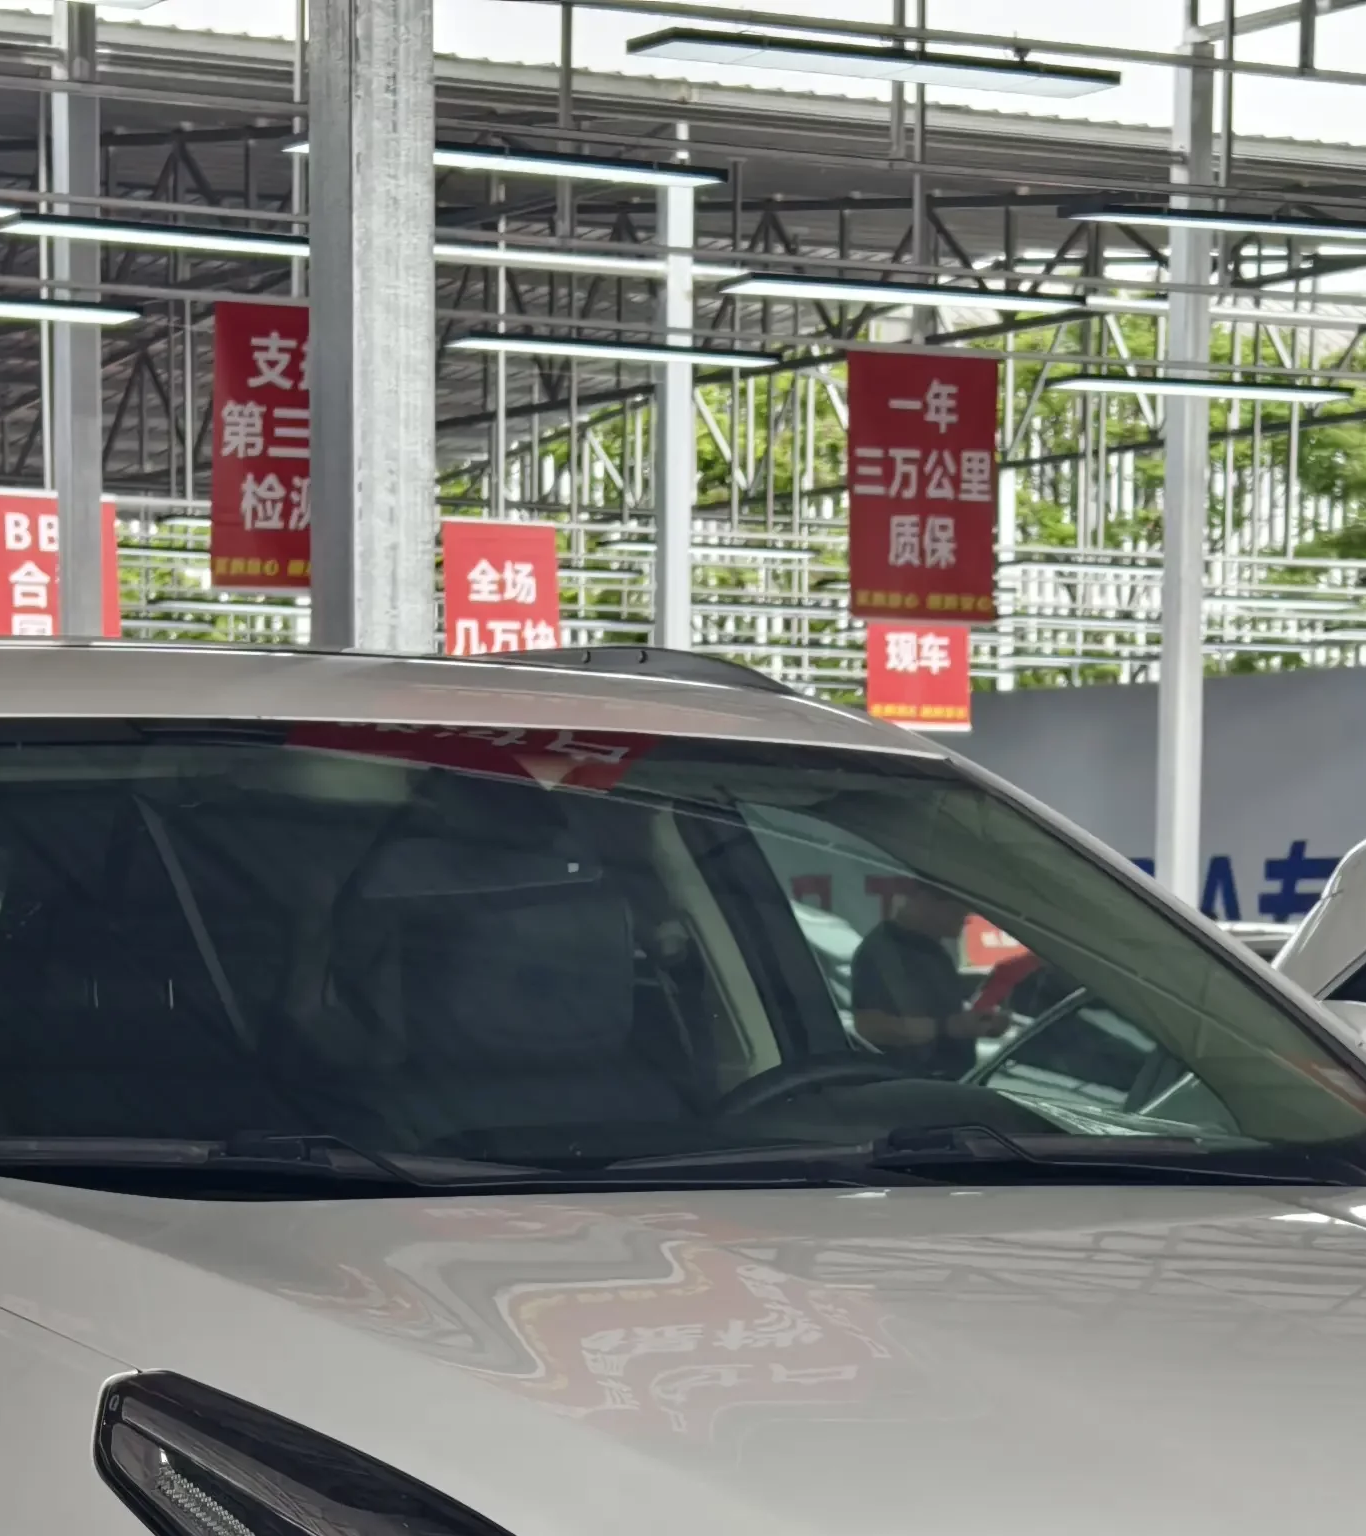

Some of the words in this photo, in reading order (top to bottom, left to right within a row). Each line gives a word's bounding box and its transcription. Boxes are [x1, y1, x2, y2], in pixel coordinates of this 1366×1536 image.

[888, 379, 958, 433] 一年
[854, 448, 992, 502] 三万公里
[888, 515, 956, 568] 质保
[467, 558, 536, 604] 全场
[885, 632, 950, 674] 现车
